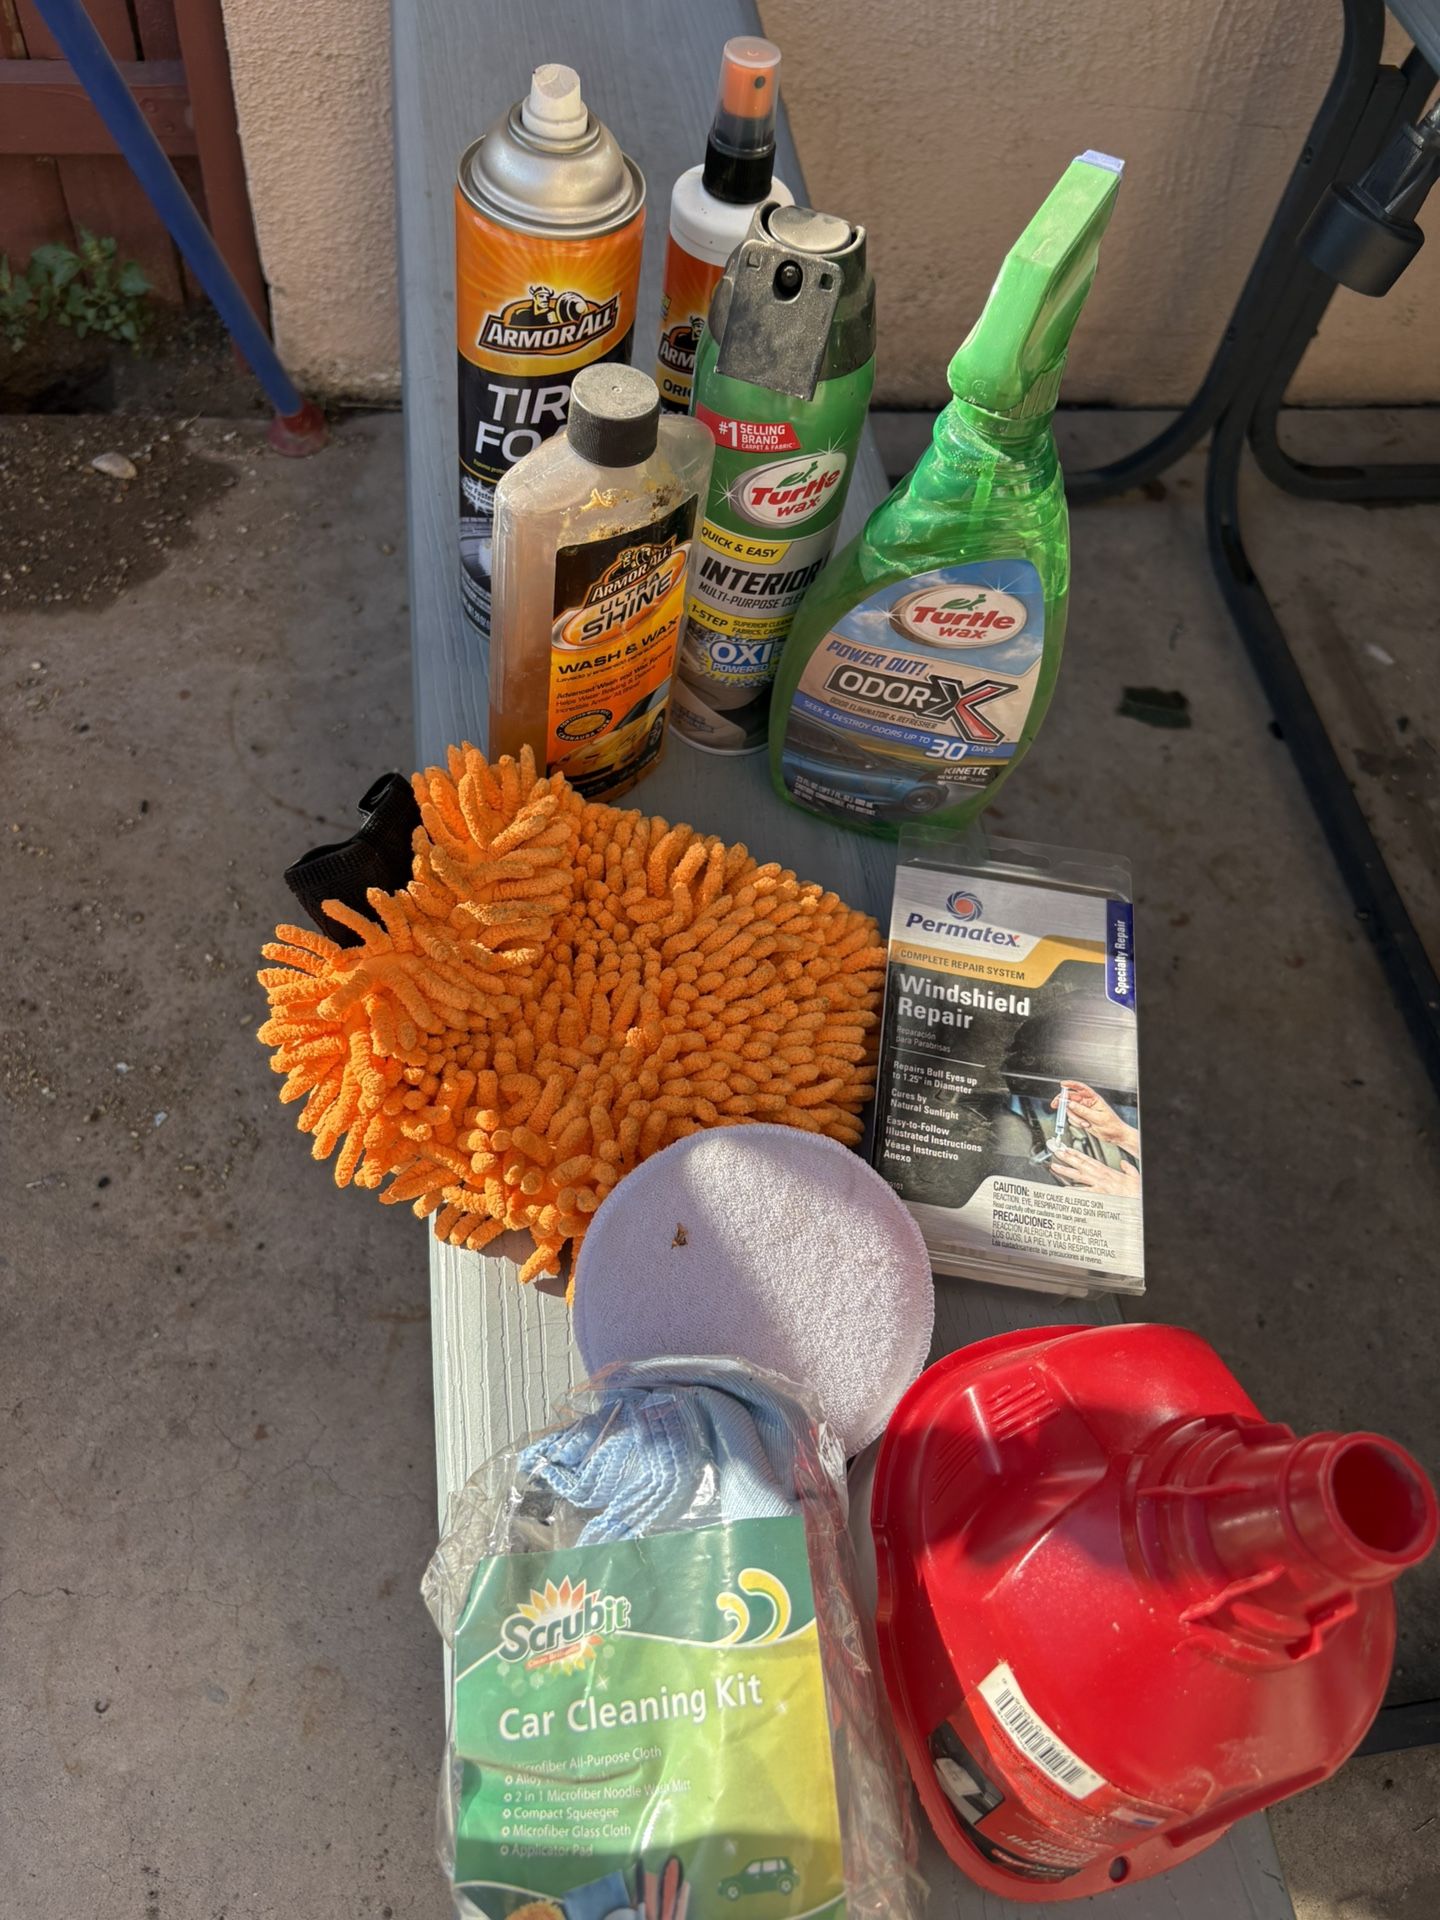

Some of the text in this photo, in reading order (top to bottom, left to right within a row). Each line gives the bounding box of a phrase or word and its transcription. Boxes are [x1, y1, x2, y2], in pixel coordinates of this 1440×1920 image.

[487, 383, 572, 425] TIR
[474, 420, 568, 463] FO
[718, 421, 785, 448] #1 SELLING
[741, 433, 779, 445] BRAND
[751, 469, 841, 506] Turtle
[776, 495, 819, 517] wax
[701, 525, 780, 559] QUICK & EASY
[699, 556, 823, 597] INTERIOR
[599, 571, 661, 614] ULTRA
[699, 580, 779, 609] MULTI-PURPOSE
[581, 575, 674, 642] SHINE
[691, 604, 728, 627] 1-STEP
[912, 606, 1016, 630] Turtle
[938, 626, 985, 640] wax
[558, 650, 621, 675] WASH
[625, 643, 638, 656] &
[642, 620, 677, 646] WAX
[711, 641, 773, 665] OXI
[827, 640, 928, 677] POWER OUT!
[712, 663, 769, 674] POWERED
[849, 702, 888, 719] ELIMINATOR
[896, 716, 938, 730] REFRESHER
[804, 700, 823, 714] SEEK
[832, 712, 871, 730] DESTROY
[871, 723, 903, 739] ODORS
[903, 732, 916, 741] UP
[919, 736, 931, 744] TO
[925, 738, 968, 761] 30
[971, 745, 994, 754] DAYS
[944, 766, 991, 776] KINETIC
[905, 911, 1020, 947] Permatex
[900, 949, 1026, 982] COMPLETE REPAIR SYSTEM
[1114, 920, 1130, 995] Specialty Repair
[899, 972, 1031, 1017] Windshield
[897, 996, 974, 1029] Repair
[895, 1034, 912, 1047] para
[892, 1071, 901, 1080] to
[923, 1077, 933, 1086] in
[933, 1080, 973, 1095] Diameter
[893, 1060, 978, 1087] Repairs Bull Eyes up
[891, 1087, 928, 1105] Cures by
[890, 1099, 960, 1120] Natural Sunlight
[886, 1115, 950, 1136] Easy-to-Follow
[885, 1126, 983, 1152] Illustrated Instructions
[883, 1149, 912, 1163] Anexo
[912, 1144, 959, 1161] Instructivo
[992, 1201, 1005, 1209] Read
[1005, 1203, 1024, 1213] carefully
[993, 1181, 1104, 1210] CAUTION: MAY CAUSE ALLERGIC SKIN
[1033, 1199, 1070, 1213] RESPIRATORY
[1070, 1206, 1082, 1215] AND
[1083, 1208, 1096, 1217] SKIN
[992, 1209, 1102, 1238] PRECAUCIONES: PUEDE CAUSAR
[1053, 1230, 1063, 1239] EN
[1063, 1232, 1072, 1241] LA
[992, 1230, 1005, 1239] LOS
[1023, 1235, 1033, 1244] LA
[1033, 1237, 1046, 1246] PIEL
[1067, 1243, 1117, 1259] RESPIRATORIAS.
[1049, 1251, 1079, 1261] precauciones
[499, 1672, 763, 1742] Car Cleaning Kit
[569, 1752, 631, 1770] All-Purpose
[632, 1745, 662, 1760] Cloth
[515, 1774, 542, 1787] Alloy
[515, 1792, 522, 1802] 2
[524, 1791, 535, 1802] in
[538, 1790, 544, 1801] 1
[547, 1786, 601, 1802] Microfiber
[604, 1785, 642, 1798] Noodle
[671, 1778, 692, 1793] Mitt
[513, 1806, 620, 1822] Compact Squeegee
[512, 1823, 632, 1837] Microfiber Glass Cloth
[512, 1844, 593, 1858] Applicator Pad
